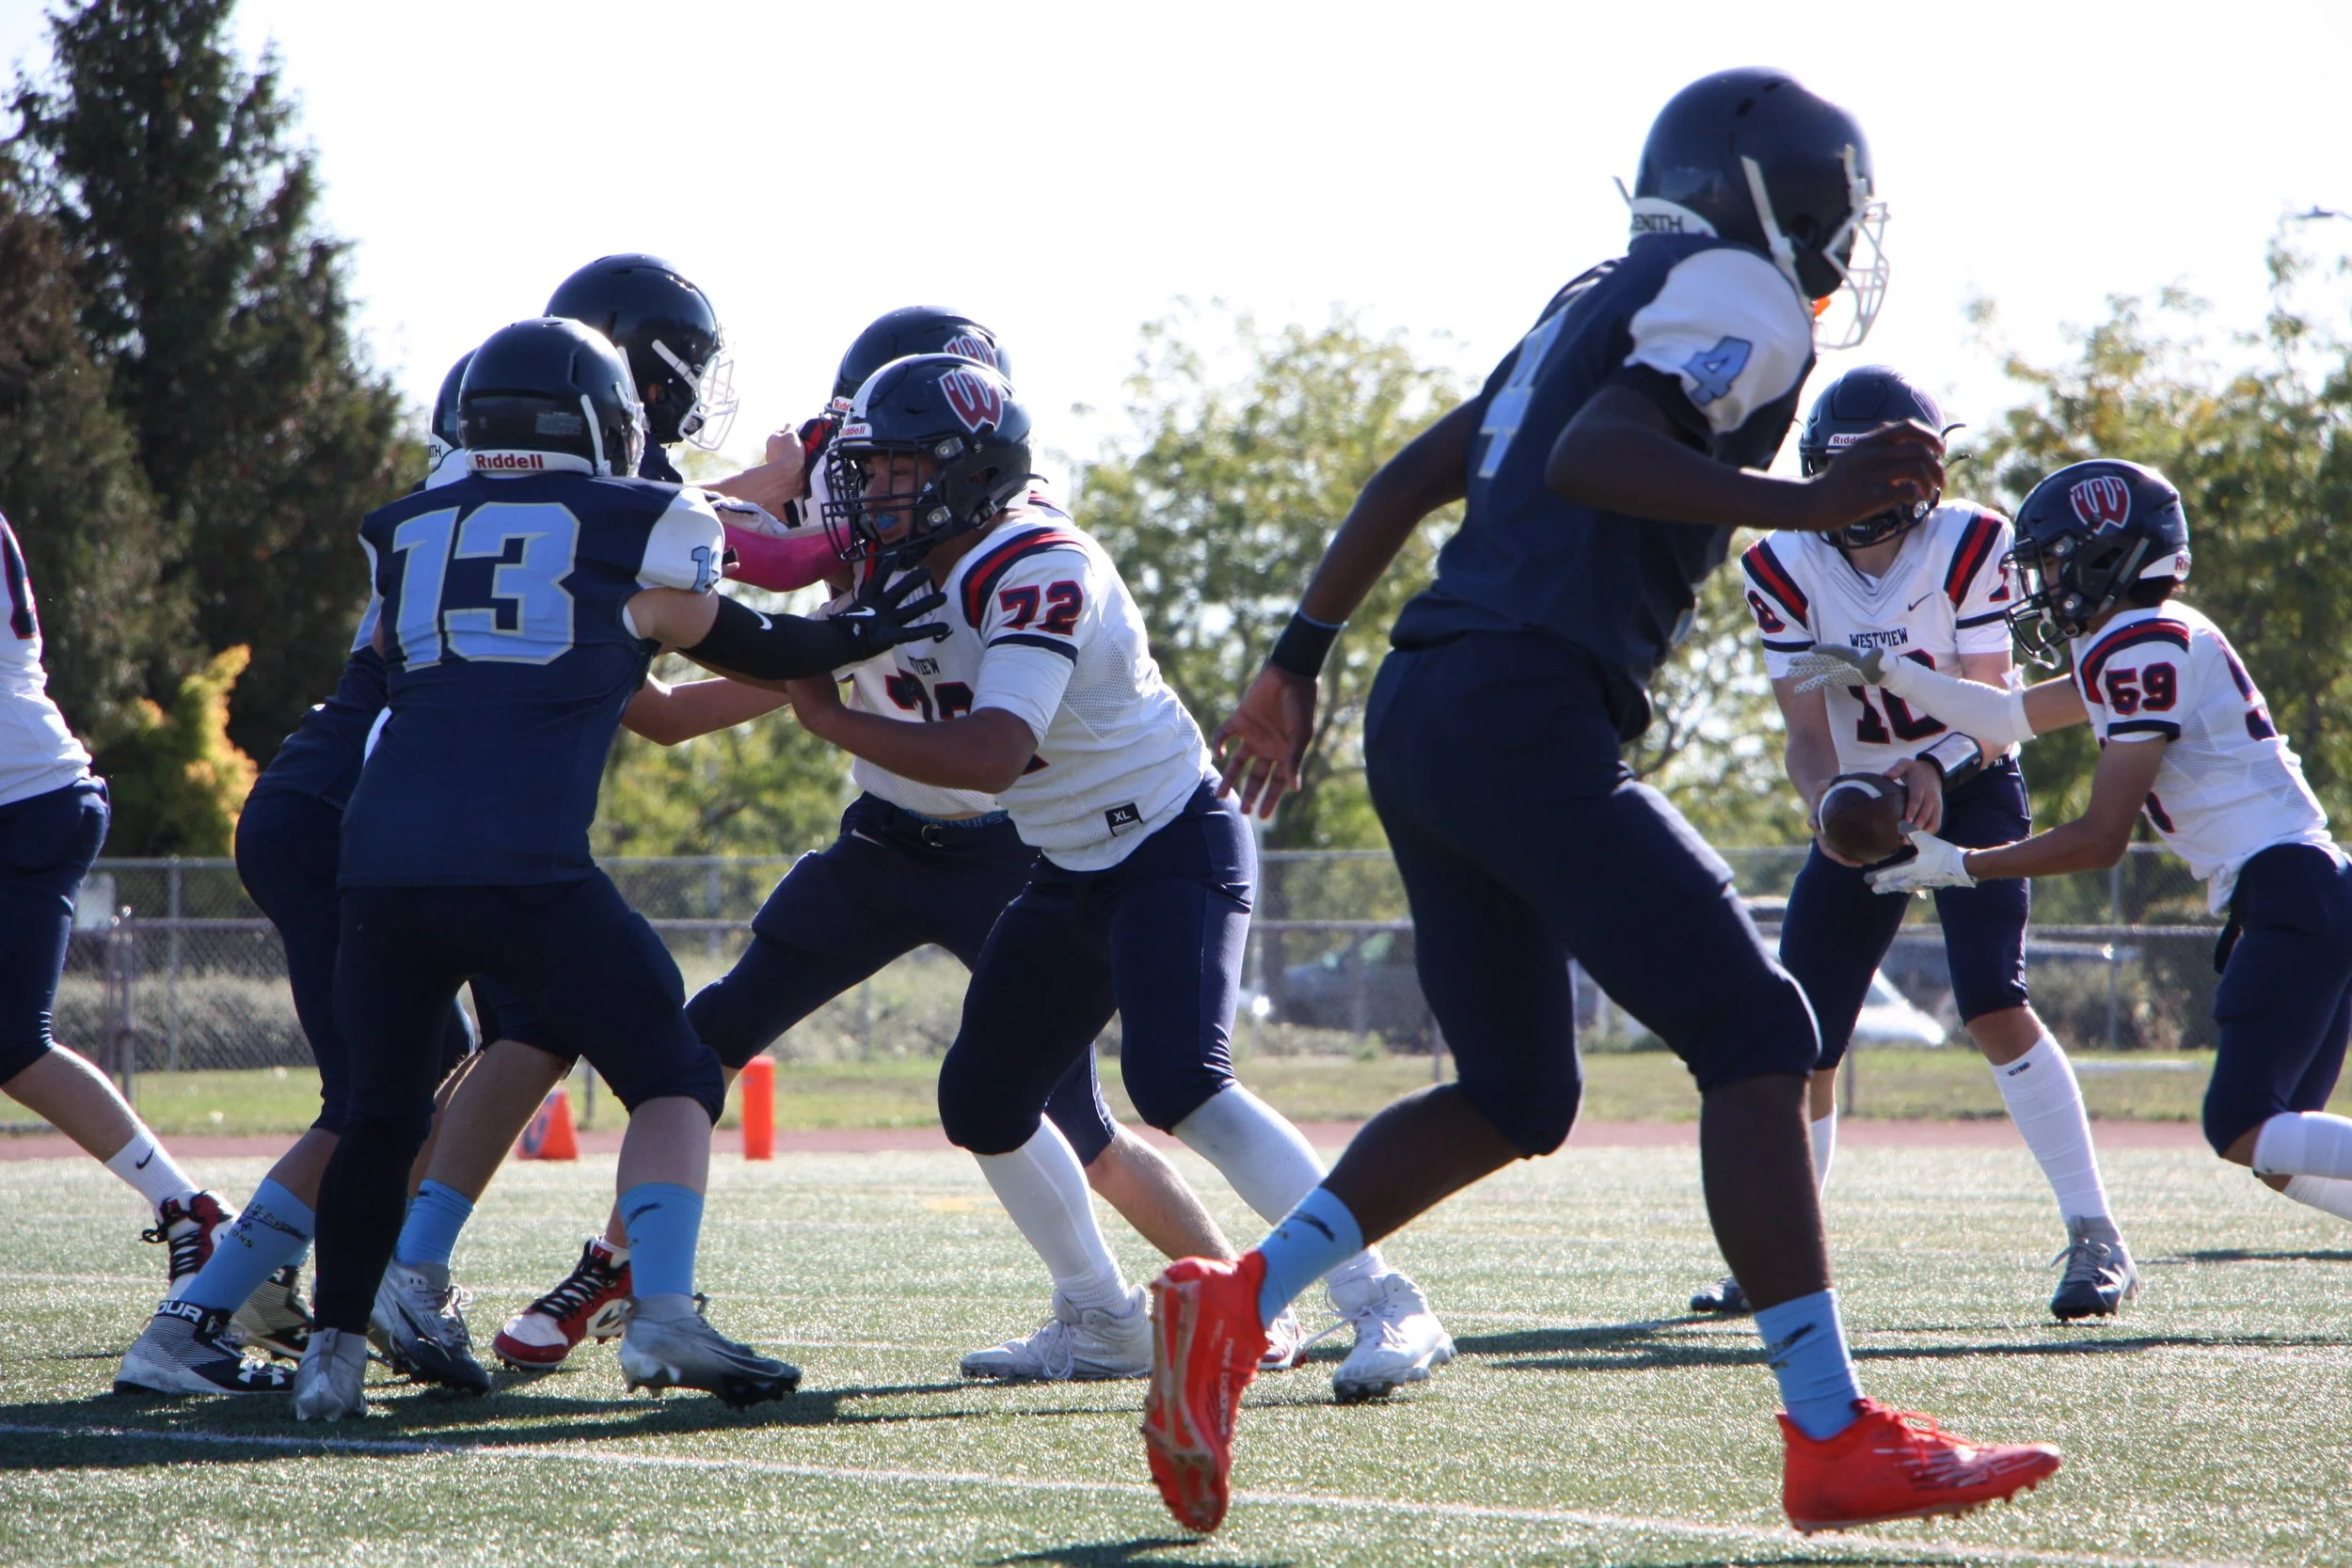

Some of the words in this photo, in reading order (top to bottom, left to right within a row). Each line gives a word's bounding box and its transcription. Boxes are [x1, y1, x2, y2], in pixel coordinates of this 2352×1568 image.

[1681, 336, 1754, 406] 4
[474, 453, 545, 469] Riddell
[2070, 475, 2131, 534] W
[391, 501, 581, 673] 13
[998, 579, 1084, 637] 72
[1849, 627, 1909, 649] WESTVIEW
[2105, 661, 2177, 716] 59
[1113, 810, 1132, 823] XL
